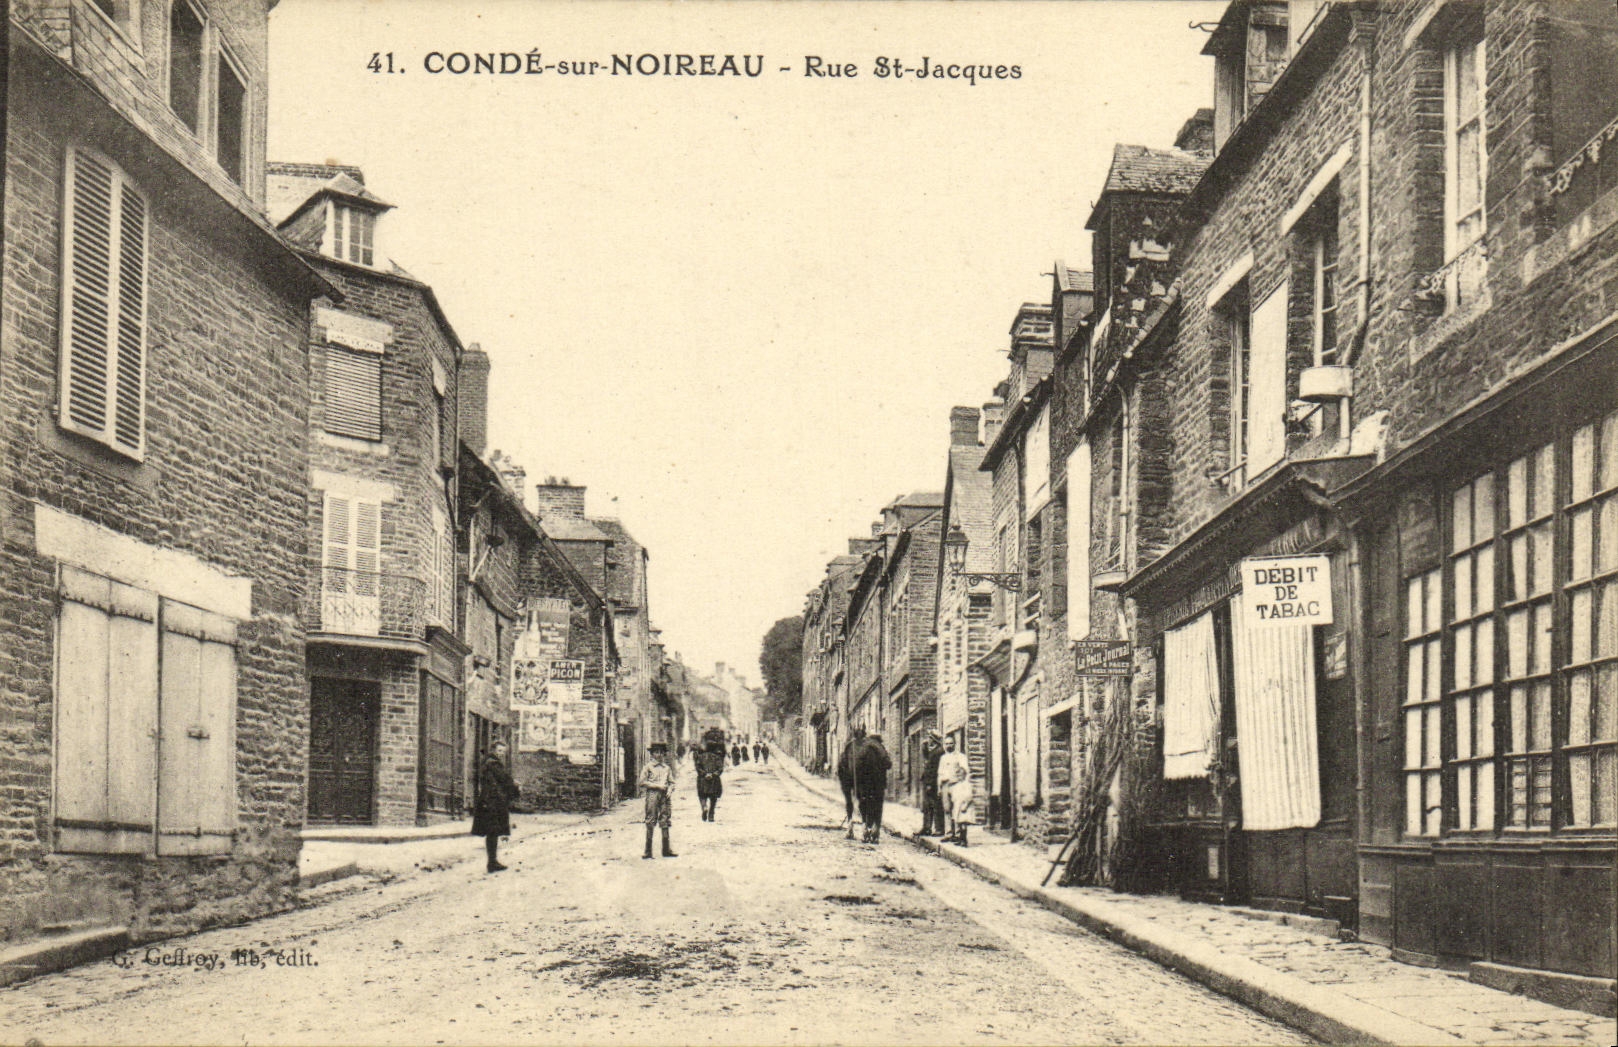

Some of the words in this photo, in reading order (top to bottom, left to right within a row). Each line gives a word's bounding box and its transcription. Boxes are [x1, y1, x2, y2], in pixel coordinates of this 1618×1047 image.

[1254, 563, 1318, 585] DÉBIT
[1275, 585, 1298, 601] DE
[1256, 601, 1320, 620] TABAC
